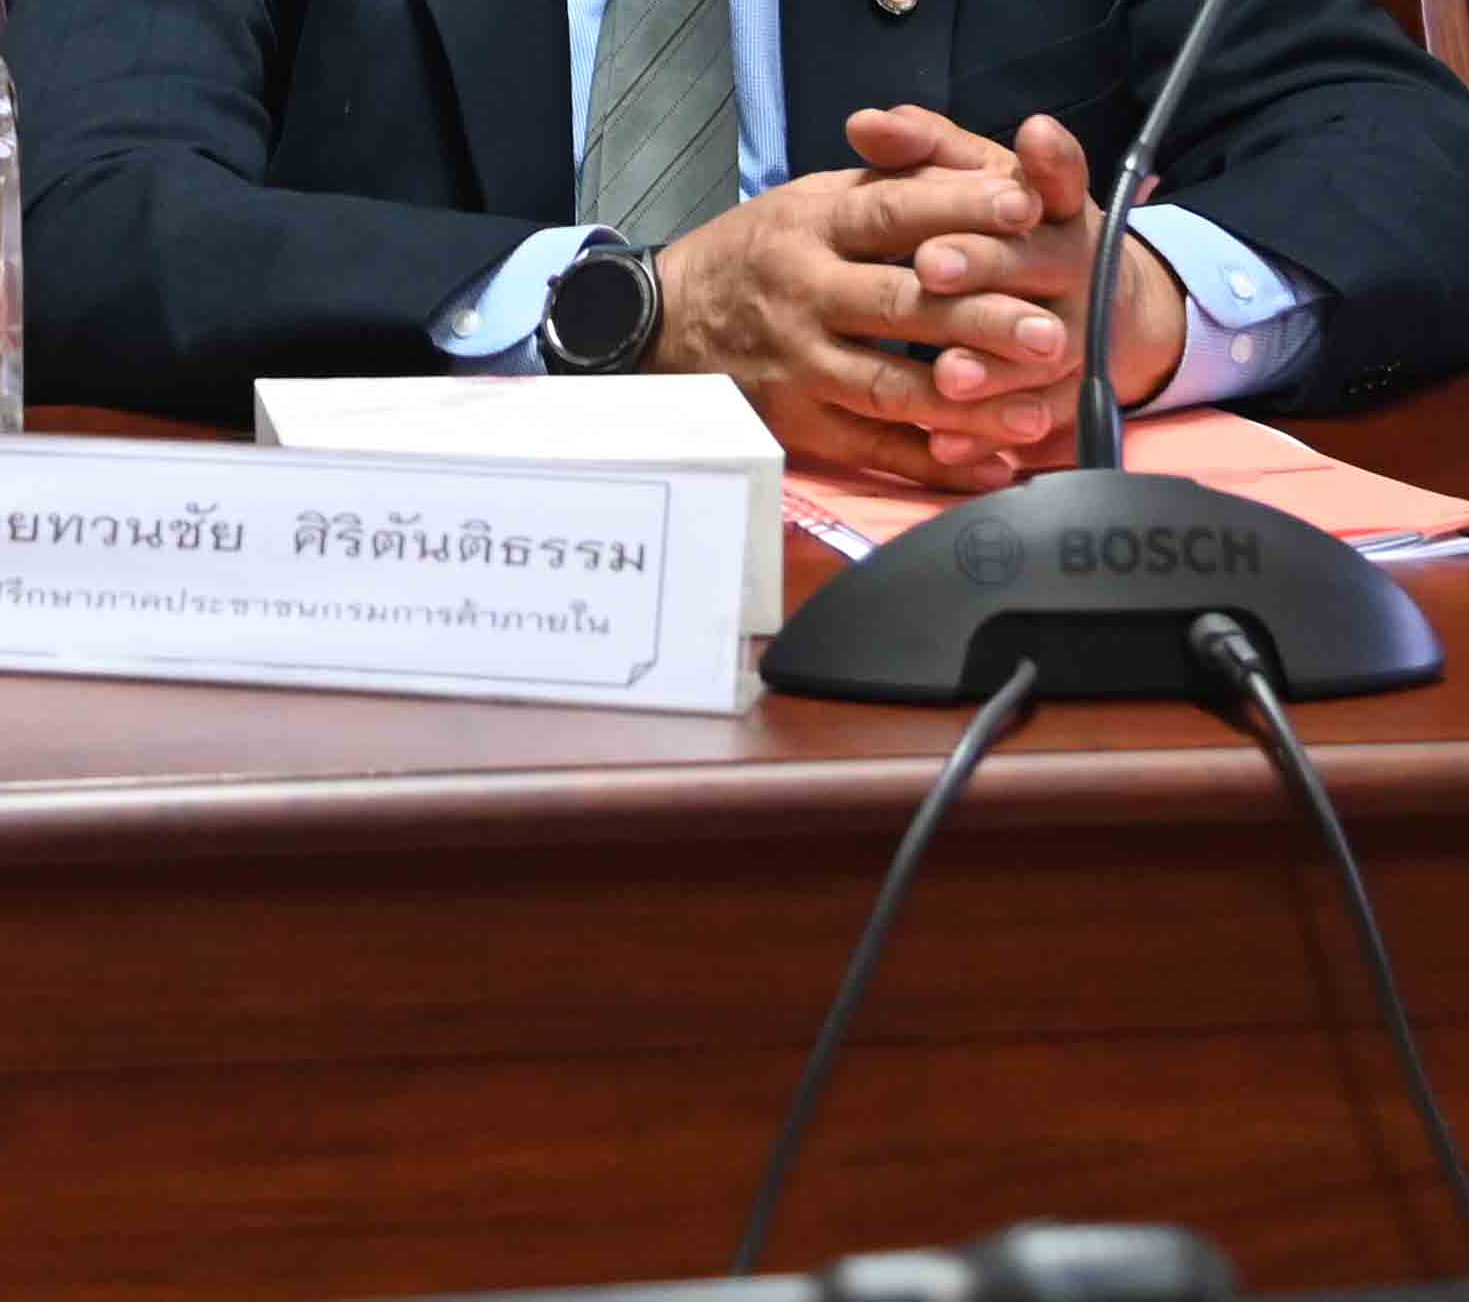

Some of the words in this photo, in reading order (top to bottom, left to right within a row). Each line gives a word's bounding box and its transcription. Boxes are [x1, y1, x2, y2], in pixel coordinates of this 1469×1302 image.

[292, 510, 648, 573] ศิริตันติธรรม
[1060, 525, 1261, 576] BOSCH
